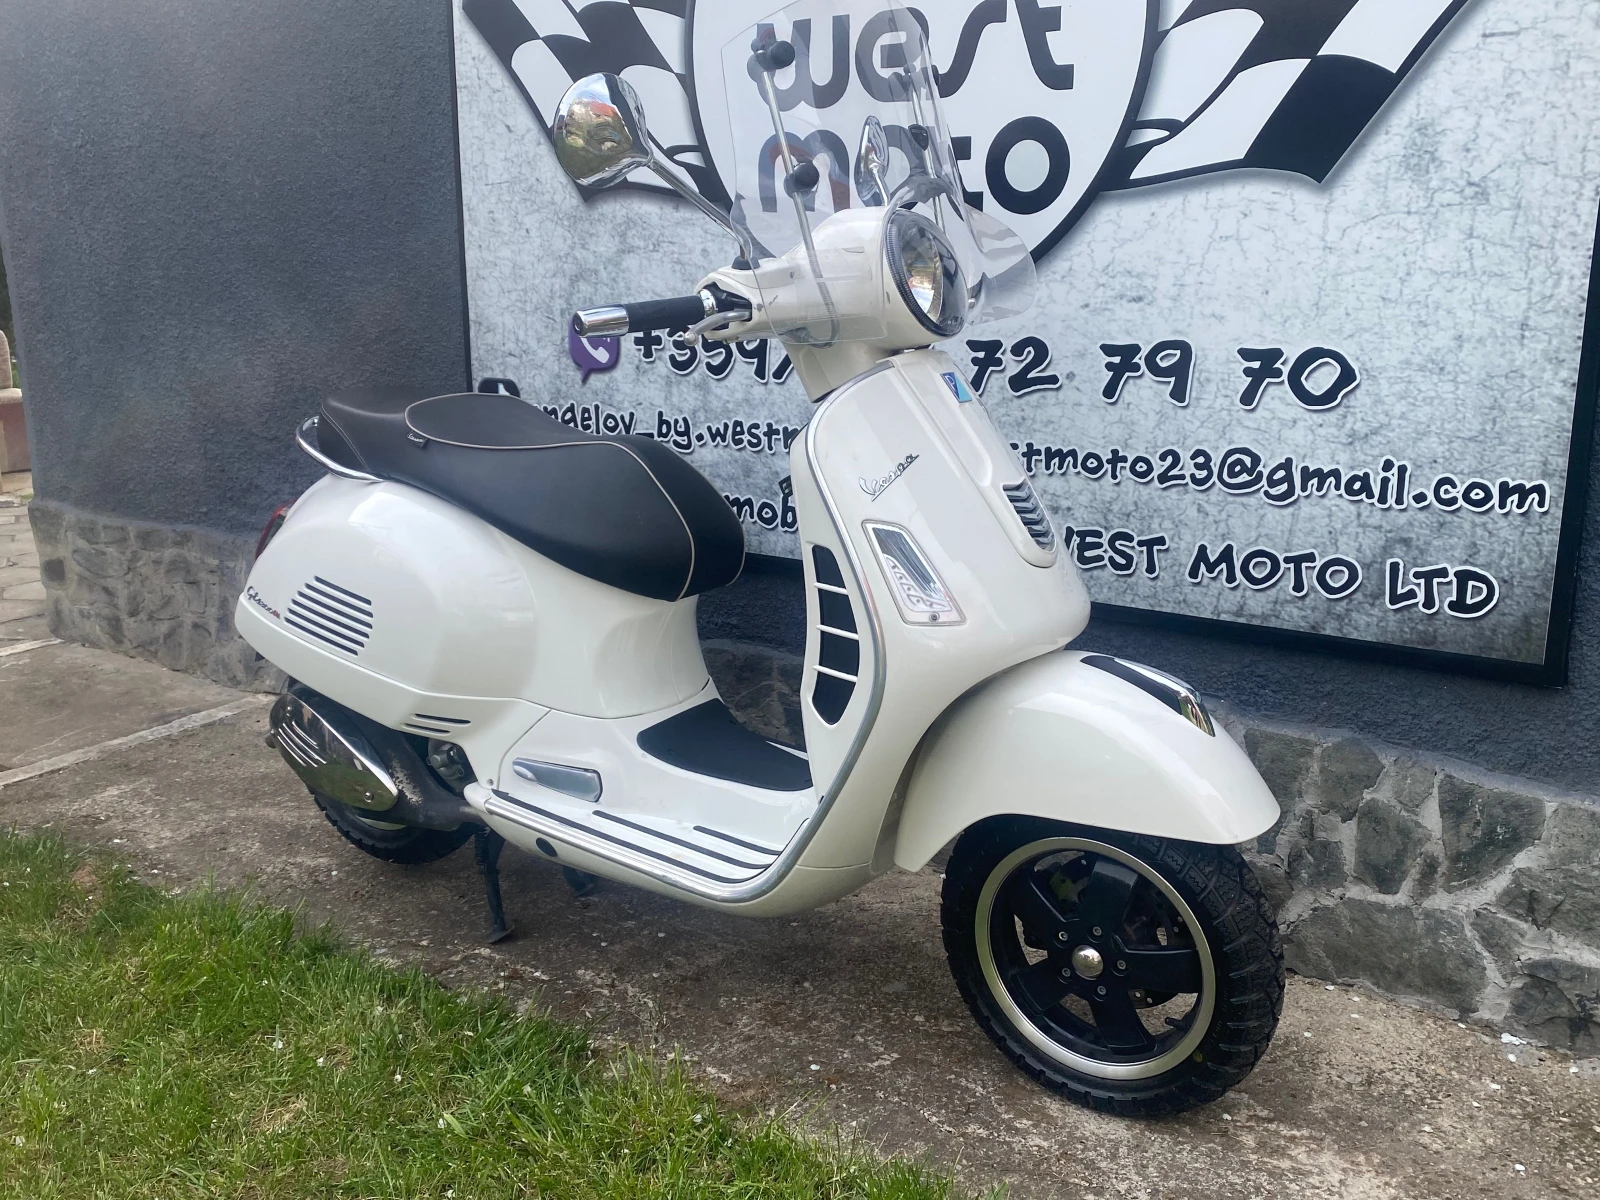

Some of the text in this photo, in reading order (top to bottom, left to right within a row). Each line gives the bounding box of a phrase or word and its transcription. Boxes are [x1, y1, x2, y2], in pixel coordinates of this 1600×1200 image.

[965, 336, 1061, 395] 72
[1099, 339, 1194, 405] 79
[1236, 345, 1360, 410] 70
[858, 453, 920, 502] Vespa
[1009, 442, 1550, 515] tmoto23@gmail.com
[1188, 542, 1362, 598] MOTO
[1386, 558, 1499, 619] LTD
